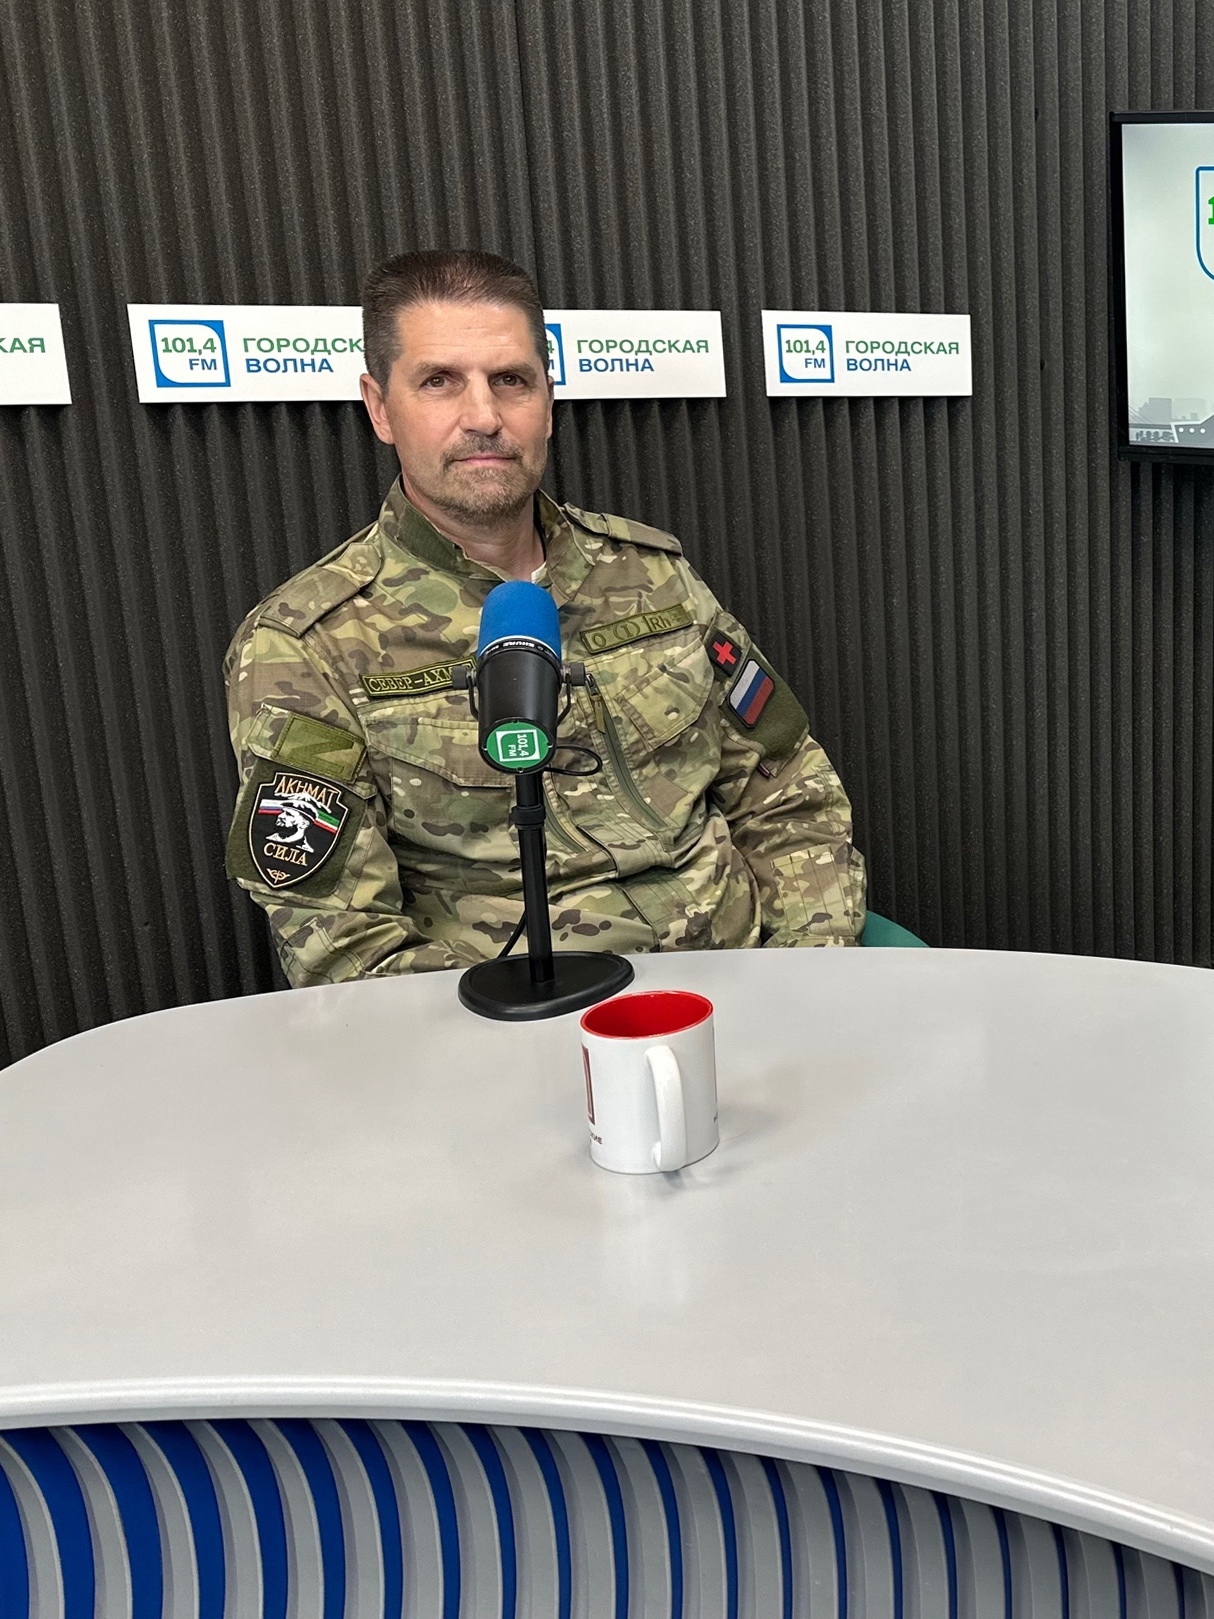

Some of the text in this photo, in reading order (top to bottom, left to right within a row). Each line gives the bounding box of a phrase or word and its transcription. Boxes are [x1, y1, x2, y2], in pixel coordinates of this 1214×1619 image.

[161, 337, 366, 355] 101,4 ГОРОДСК
[576, 339, 710, 356] ГОРОДСКАЯ
[785, 339, 960, 357] 101,4 ГОРОДСКАЯ
[189, 358, 218, 371] FM
[246, 358, 334, 373] ВОЛНА
[579, 358, 654, 373] ВОЛНА
[804, 358, 826, 369] FM
[846, 358, 912, 373] ВОЛНА
[508, 744, 517, 757] FM
[263, 842, 308, 867] СИЛА
